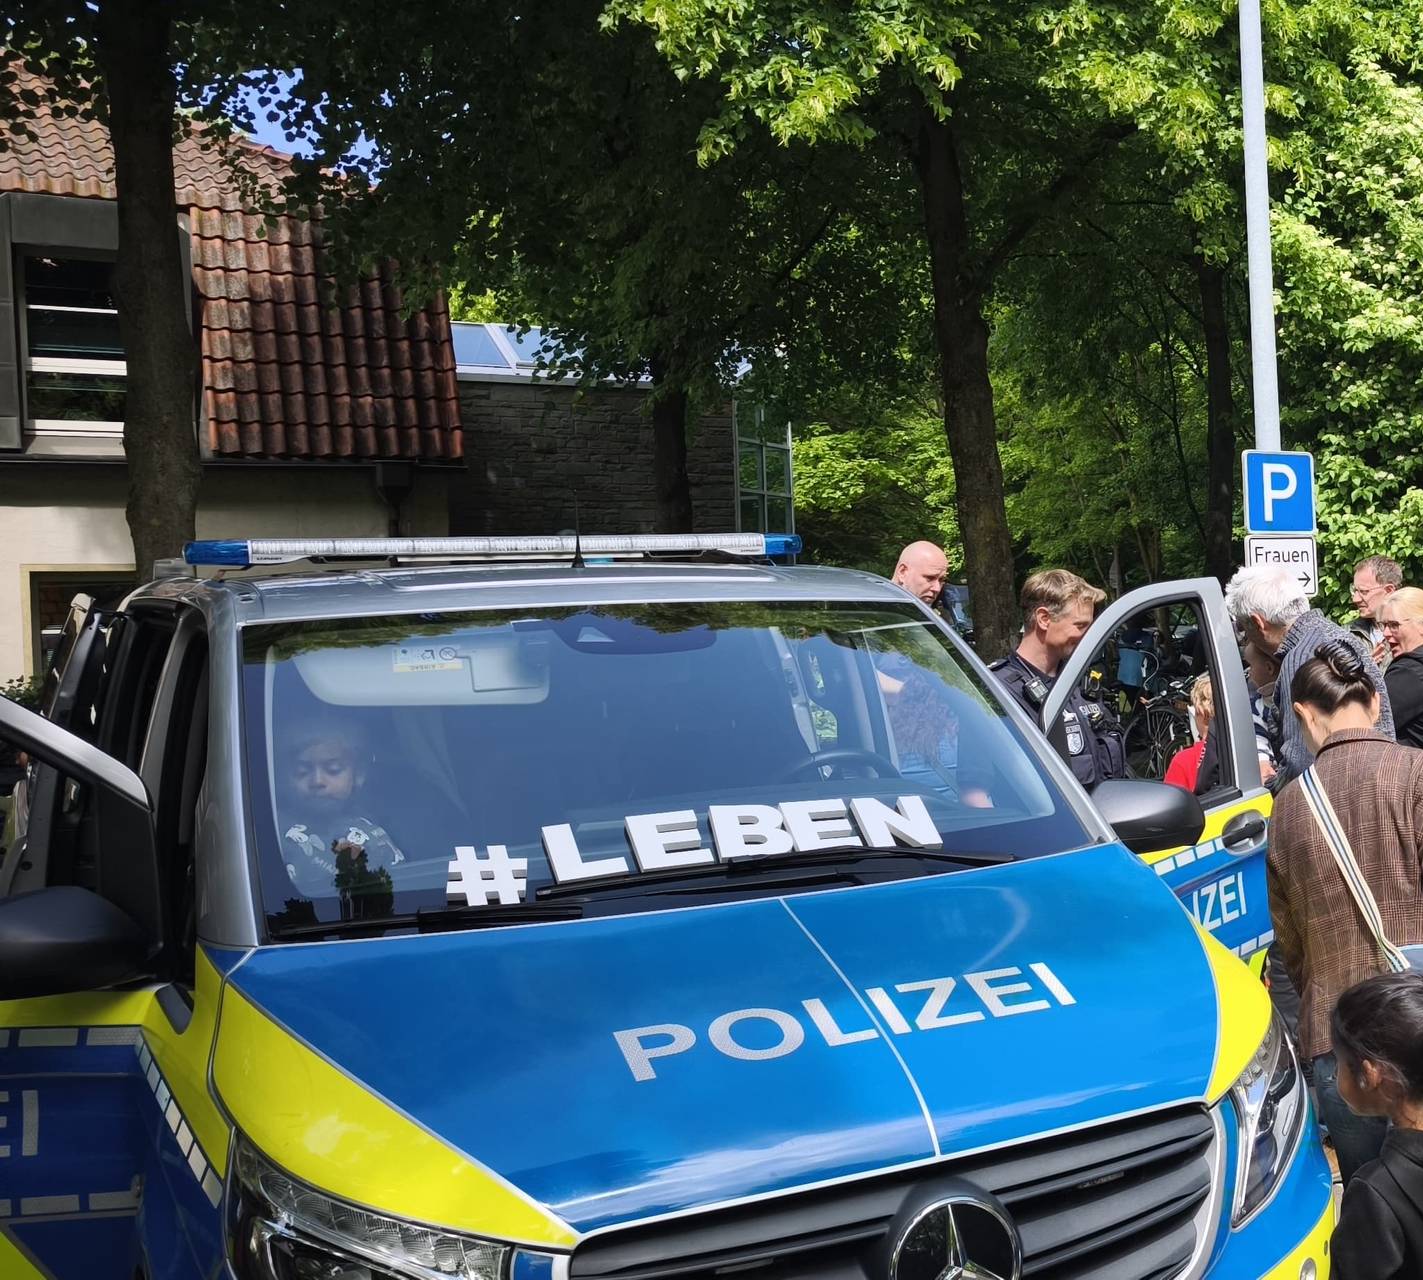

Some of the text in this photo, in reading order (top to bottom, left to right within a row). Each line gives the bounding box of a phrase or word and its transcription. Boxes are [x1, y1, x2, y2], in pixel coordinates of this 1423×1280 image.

[1262, 463, 1298, 522] P
[1254, 546, 1310, 564] Frauen
[446, 796, 944, 906] #LEBEN
[1192, 871, 1247, 932] IZEI
[612, 962, 1078, 1082] POLIZEI
